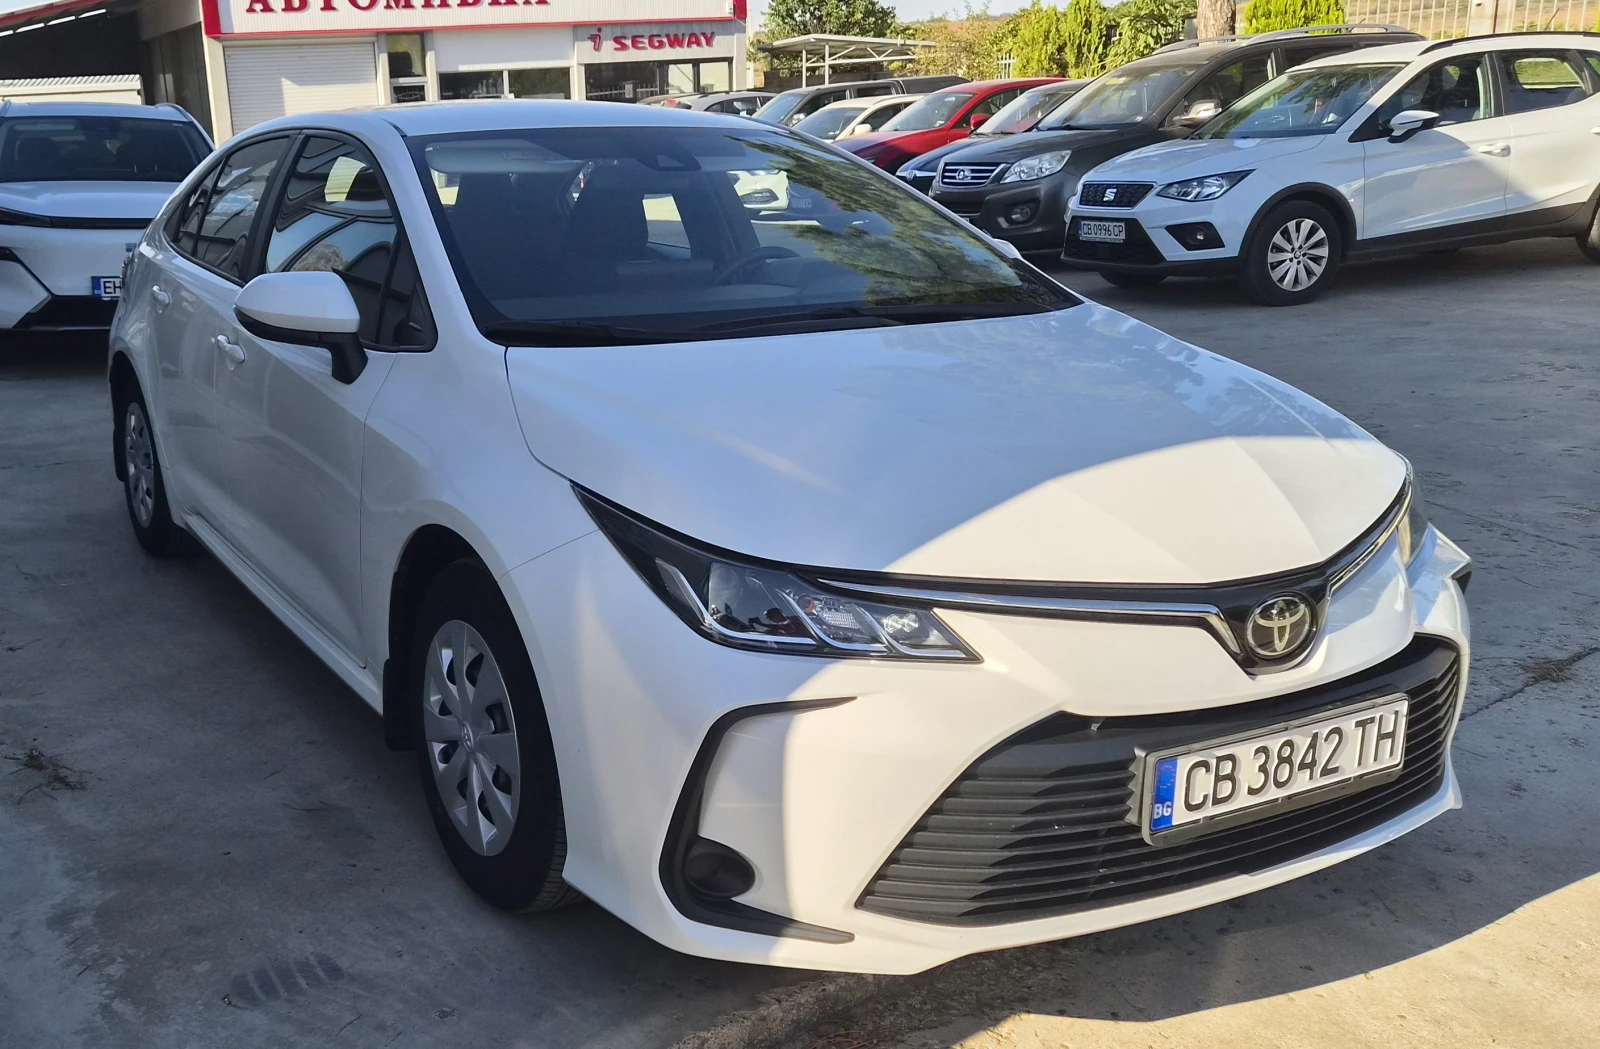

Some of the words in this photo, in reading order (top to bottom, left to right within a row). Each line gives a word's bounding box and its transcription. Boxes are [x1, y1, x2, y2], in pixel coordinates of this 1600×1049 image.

[612, 31, 715, 51] SEGWAY
[1082, 223, 1092, 235] CB
[1093, 224, 1112, 237] 0996
[1113, 225, 1124, 237] CP
[1184, 753, 1237, 812] CB
[1247, 726, 1344, 796] 3842
[1354, 709, 1400, 767] TH
[1153, 801, 1172, 819] BG
